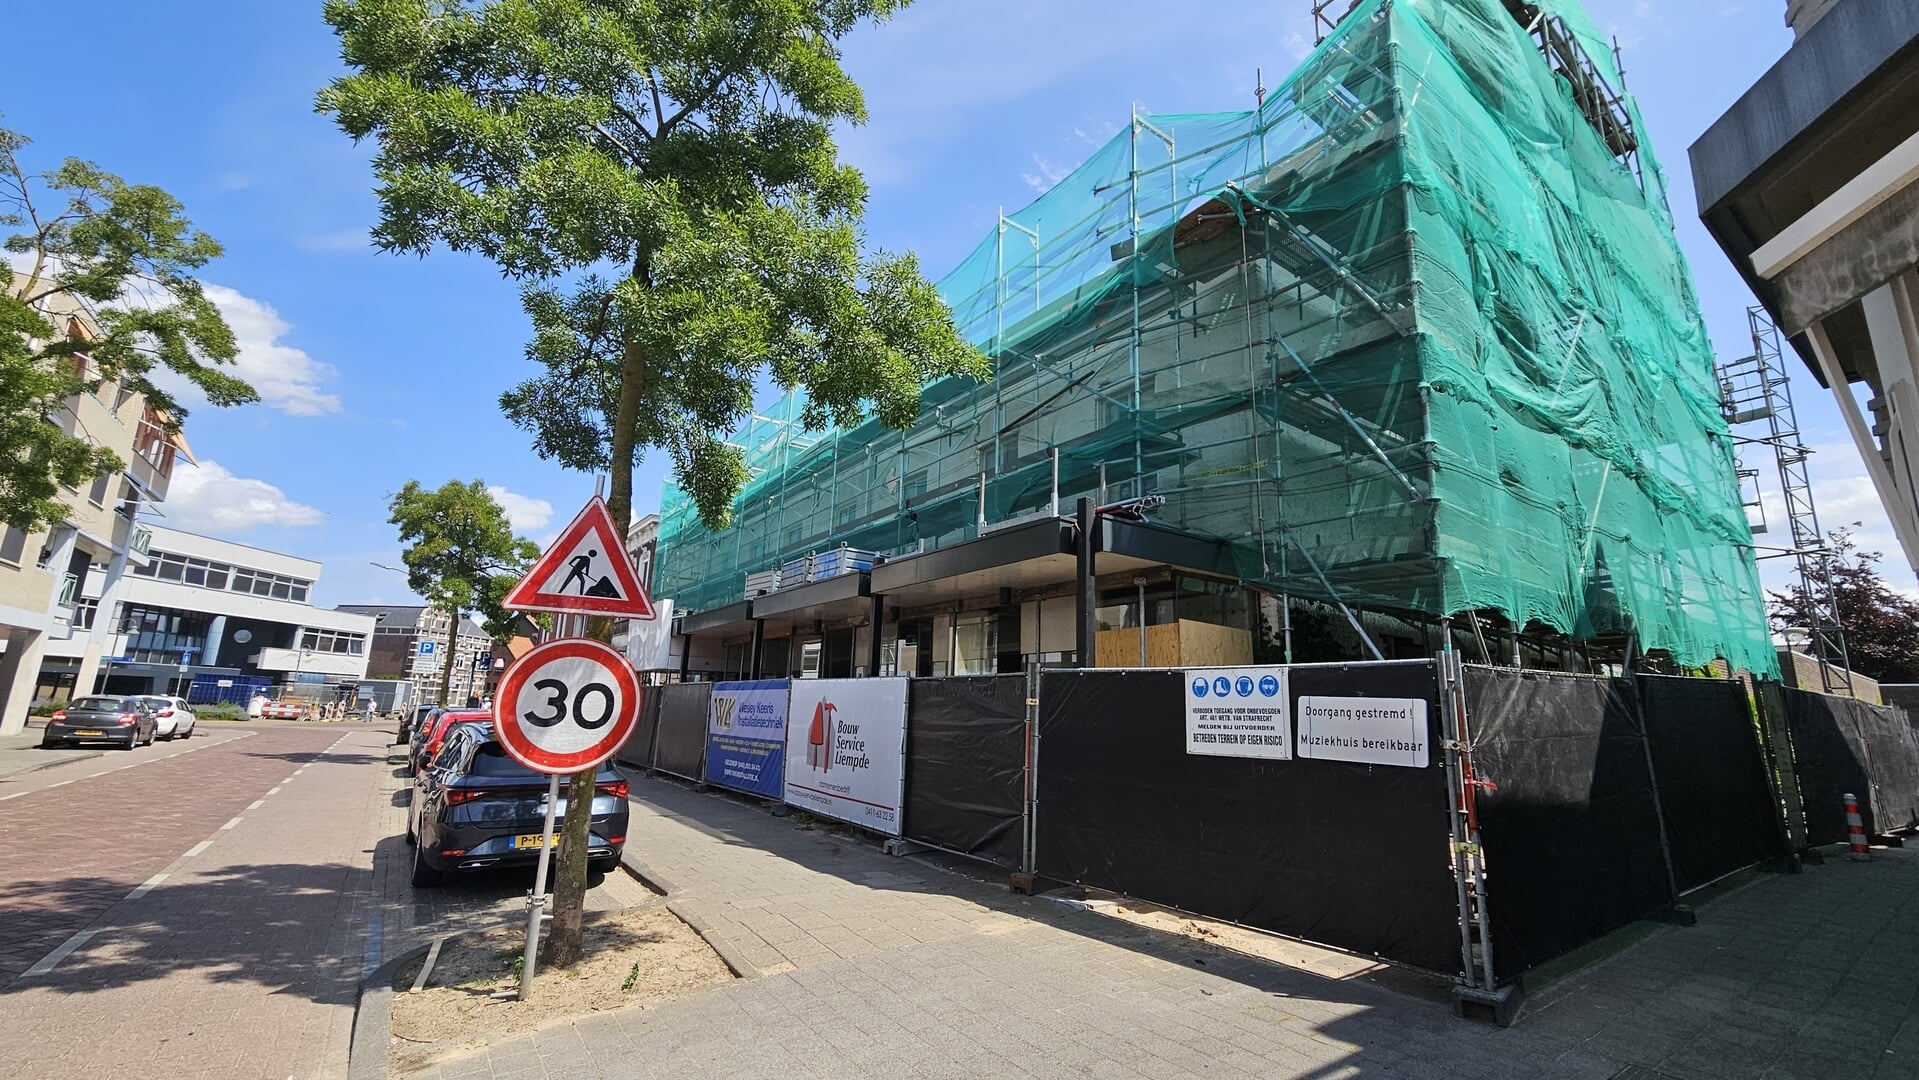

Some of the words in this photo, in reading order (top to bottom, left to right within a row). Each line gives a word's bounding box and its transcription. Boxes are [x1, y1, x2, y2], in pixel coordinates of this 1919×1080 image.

[423, 643, 431, 652] P
[482, 652, 490, 661] P
[524, 679, 614, 729] 30
[1305, 706, 1352, 720] Doorgang
[1355, 708, 1406, 720] gestremd
[838, 720, 860, 734] Bouw
[836, 735, 865, 752] Service
[1193, 733, 1217, 743] BETREDEN
[1218, 734, 1238, 744] TERREIN
[1239, 734, 1247, 744] OP
[1248, 735, 1263, 746] EIGEN
[1264, 735, 1283, 746] RISICO
[1300, 734, 1359, 748] Muziekhuis
[1362, 737, 1423, 752] bereikbaar
[835, 750, 870, 772] Liempde
